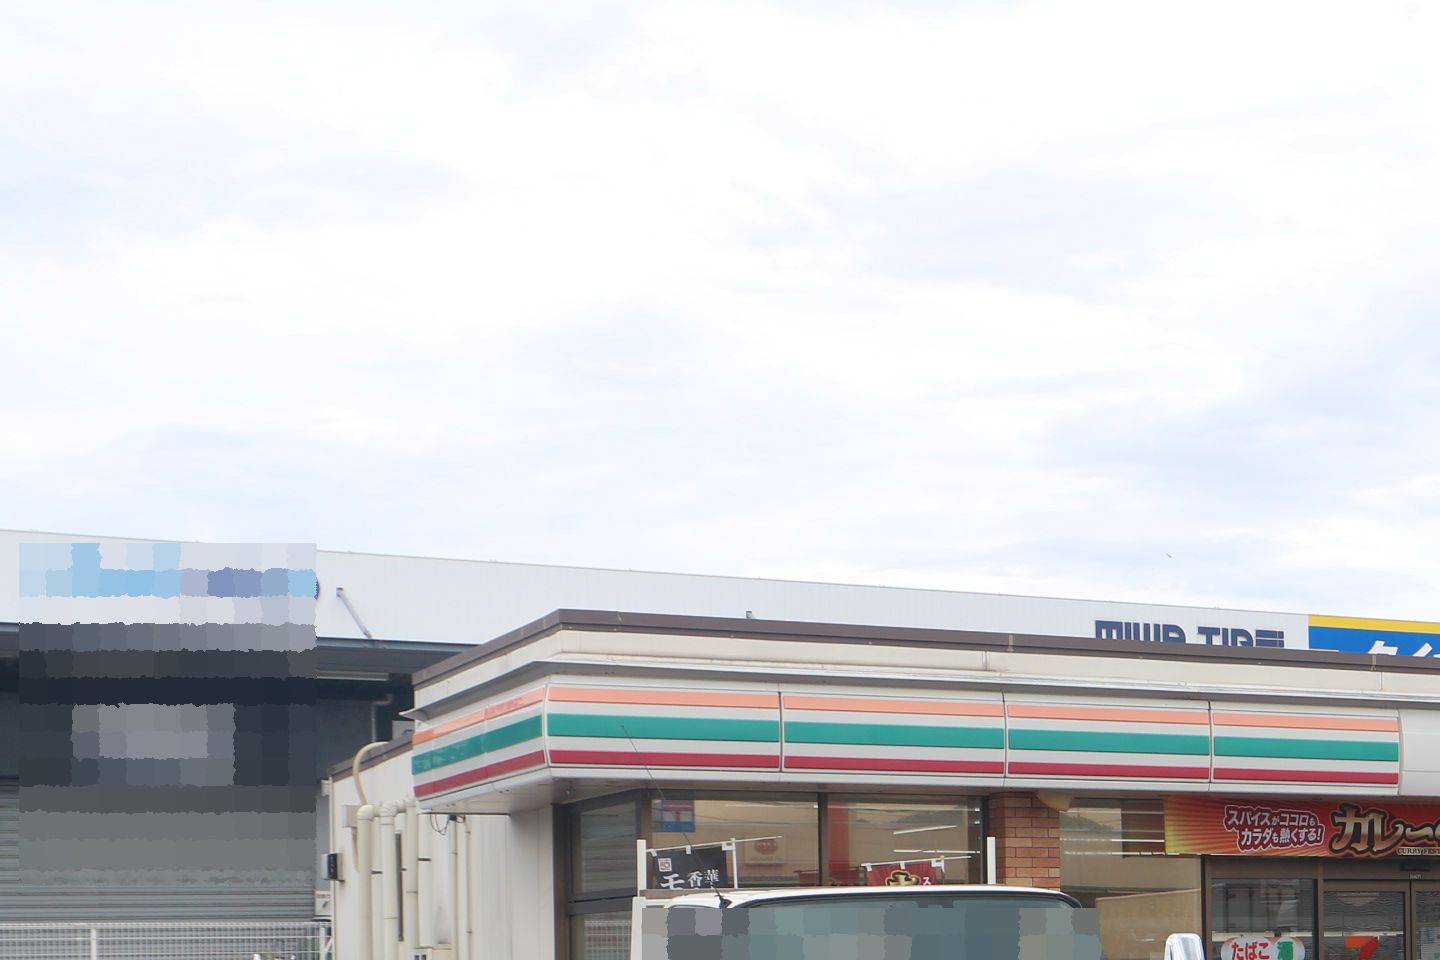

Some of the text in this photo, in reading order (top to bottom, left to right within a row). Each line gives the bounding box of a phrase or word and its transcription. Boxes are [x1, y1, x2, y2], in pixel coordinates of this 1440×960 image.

[1227, 809, 1316, 826] スパイスがココロも
[1397, 847, 1422, 855] CURRY
[1231, 941, 1270, 960] たばこ
